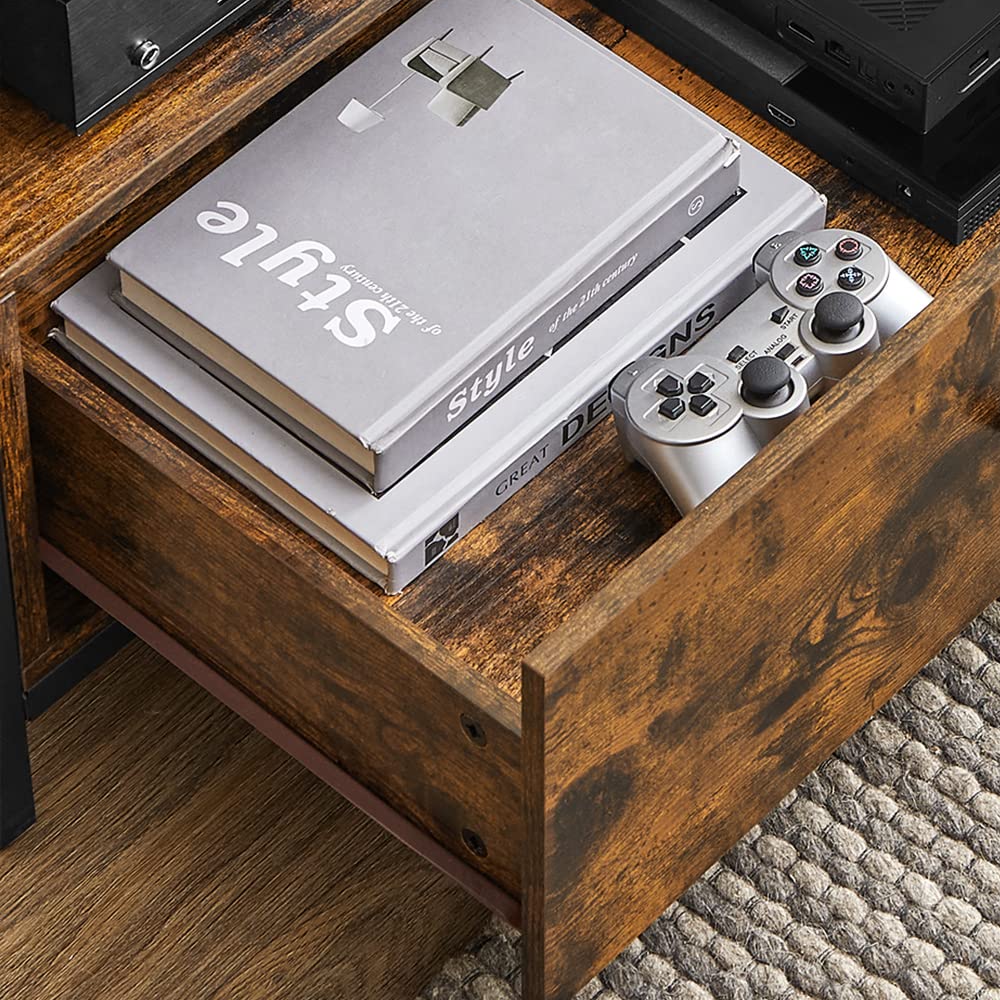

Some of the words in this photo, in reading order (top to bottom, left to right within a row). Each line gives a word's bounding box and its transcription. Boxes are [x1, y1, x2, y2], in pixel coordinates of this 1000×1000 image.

[196, 201, 402, 348] Style
[340, 264, 383, 294] century
[379, 292, 410, 314] 21th
[405, 310, 428, 326] the
[780, 313, 799, 330] START
[420, 324, 442, 336] of
[446, 335, 536, 423] Style
[549, 314, 561, 333] of
[562, 303, 578, 322] the
[602, 252, 639, 288] century
[764, 334, 788, 355] ANALOG
[735, 350, 759, 370] SELECT
[495, 444, 549, 497] GREAT
